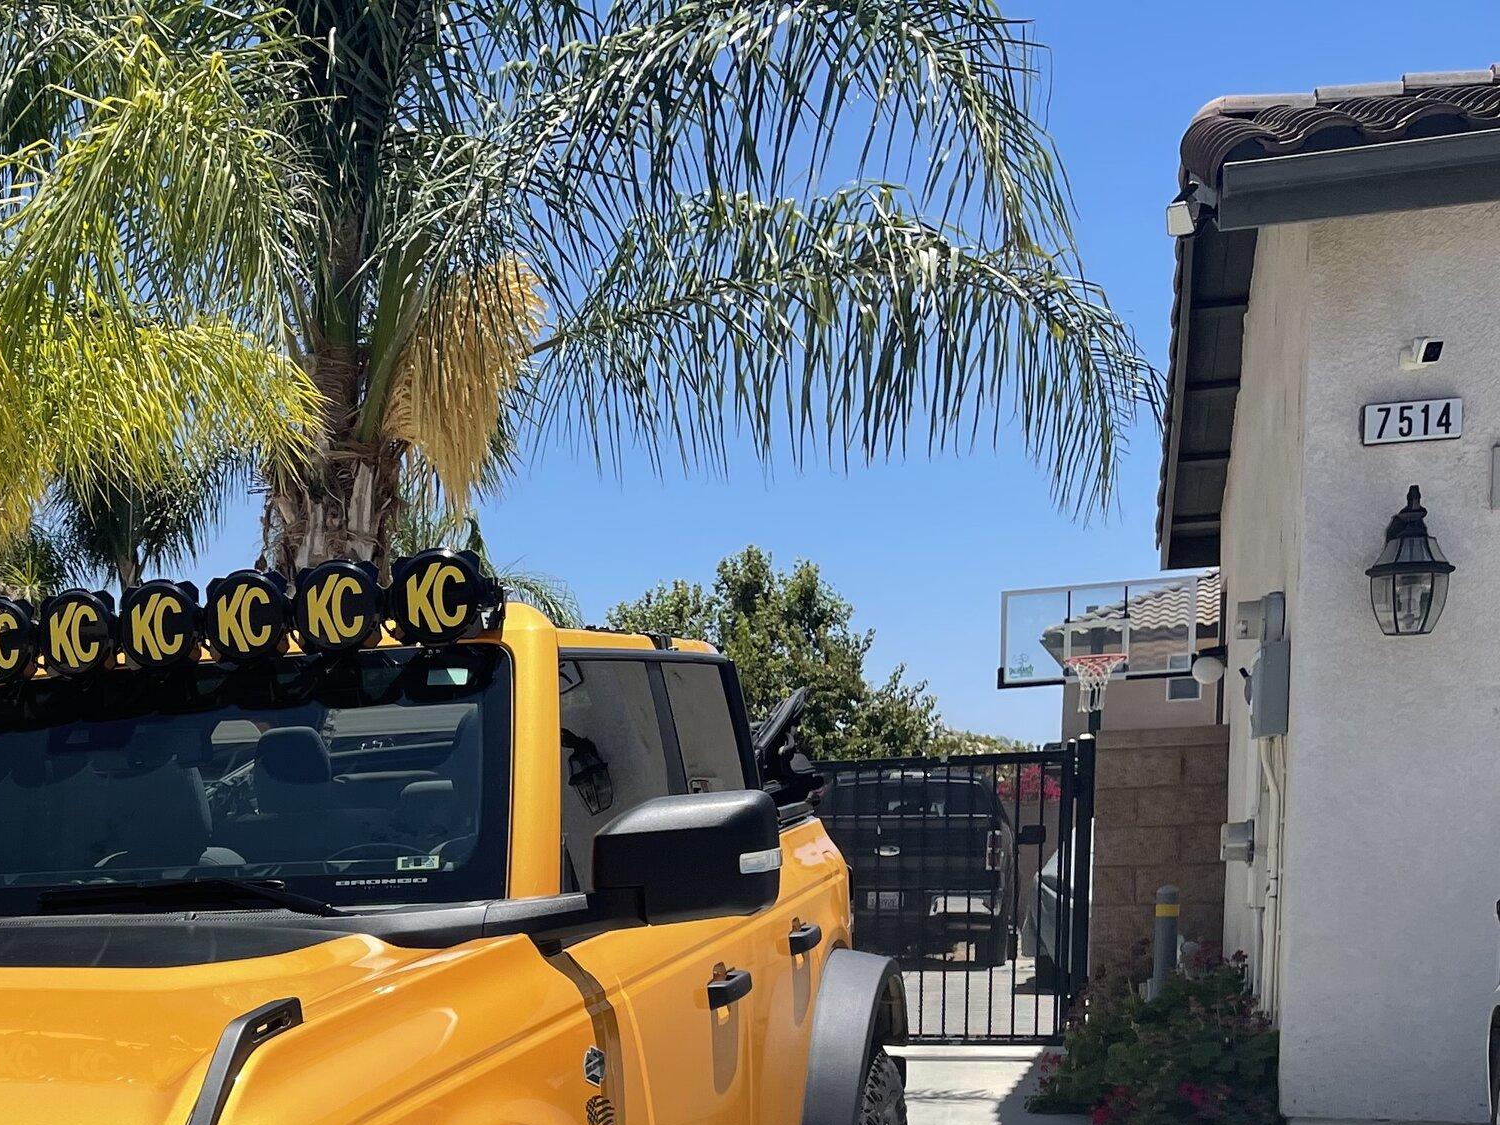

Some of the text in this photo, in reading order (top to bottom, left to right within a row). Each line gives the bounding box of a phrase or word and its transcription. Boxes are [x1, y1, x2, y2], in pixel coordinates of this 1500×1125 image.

[1376, 402, 1452, 439] 7514
[132, 595, 183, 660] KC
[218, 584, 271, 652] KC
[307, 574, 363, 643] KC
[407, 563, 467, 632] KC
[50, 602, 98, 667] KC
[336, 878, 427, 886] BRONCO
